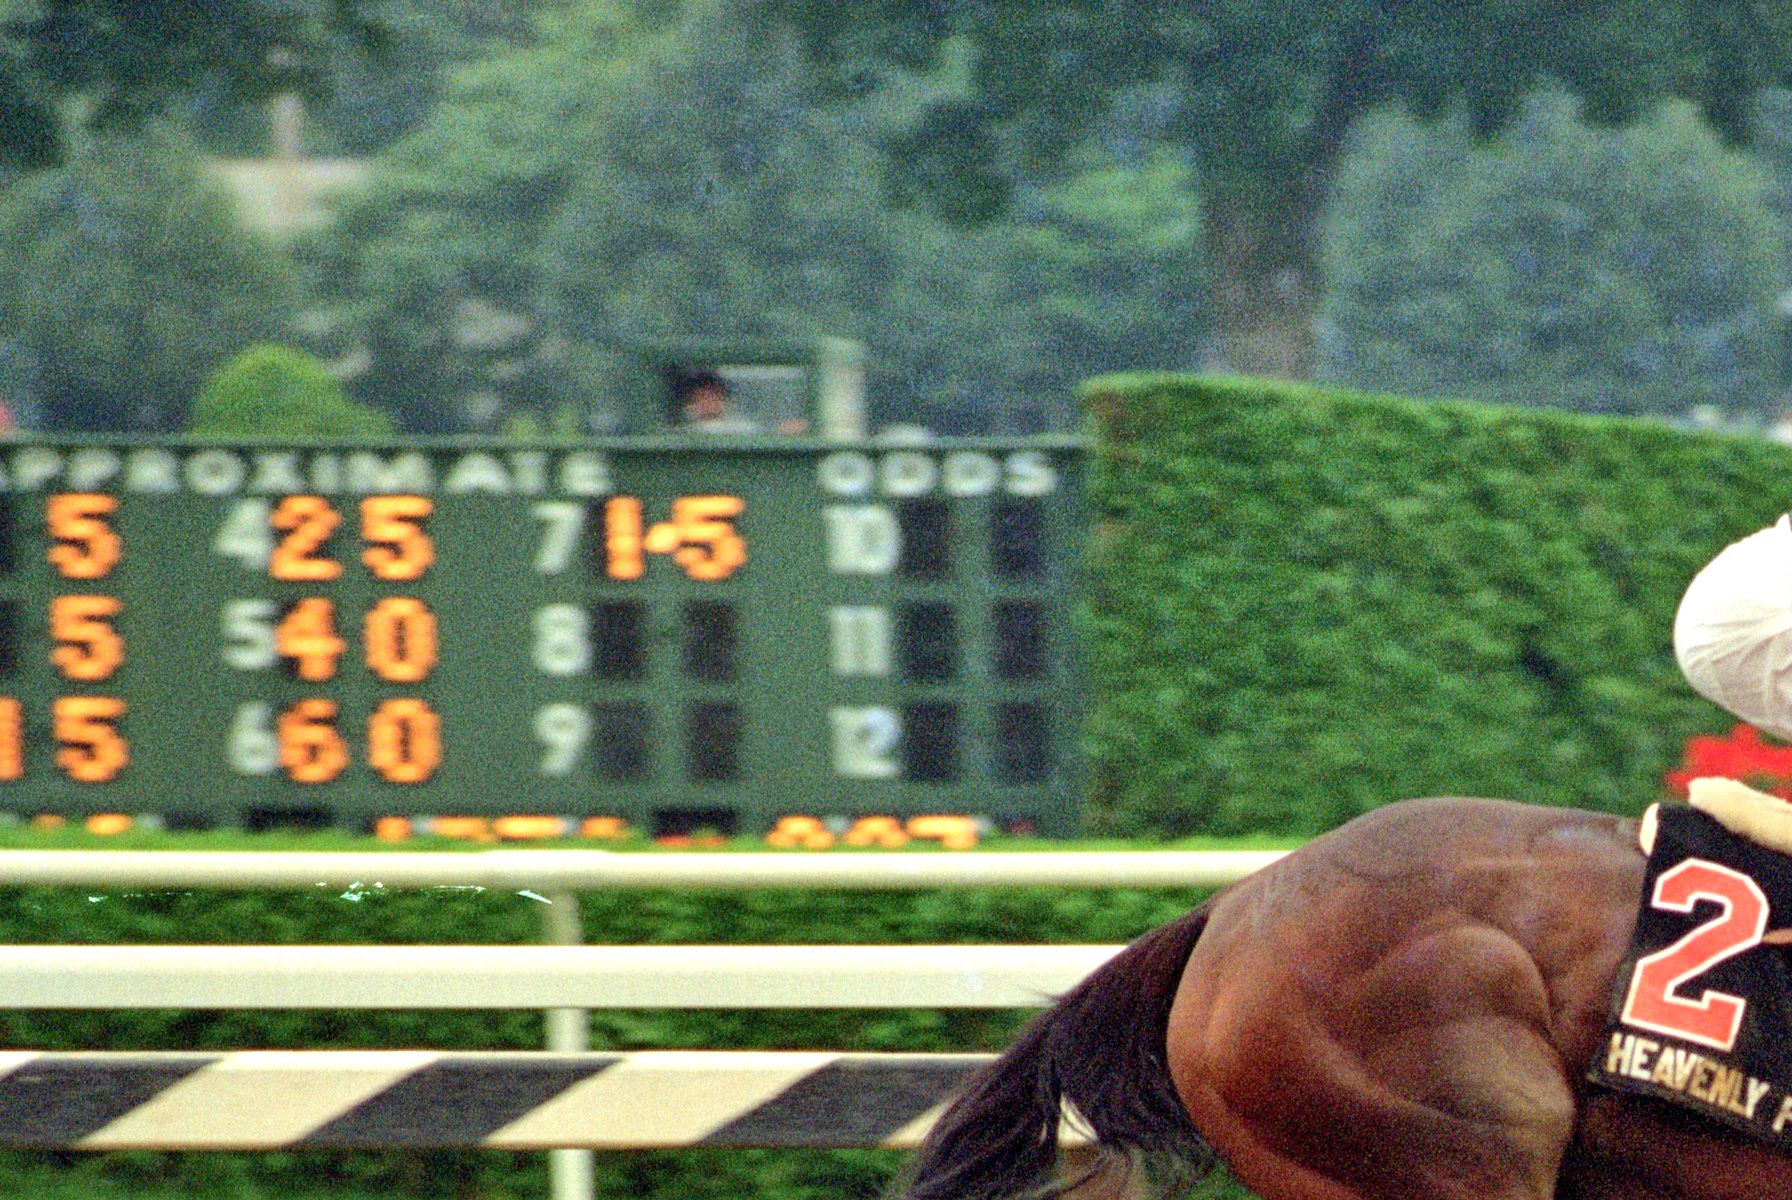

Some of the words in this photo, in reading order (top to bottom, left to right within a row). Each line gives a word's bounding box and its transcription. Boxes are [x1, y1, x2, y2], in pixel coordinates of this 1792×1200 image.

[0, 449, 612, 495] PPROXIMATE
[818, 450, 1058, 497] ODDS
[46, 493, 122, 579] 5
[214, 499, 270, 569] 4
[270, 495, 437, 580] 25
[534, 501, 584, 574] 7
[604, 495, 747, 580] 1-5
[50, 594, 126, 681] 5
[222, 600, 276, 671] 5
[275, 597, 439, 683] 40
[534, 603, 592, 676] 8
[228, 702, 280, 775] 6
[277, 699, 443, 784] 60
[534, 702, 592, 776] 9
[1621, 858, 1770, 1051] 2
[1605, 1032, 1770, 1119] HEAVENLY
